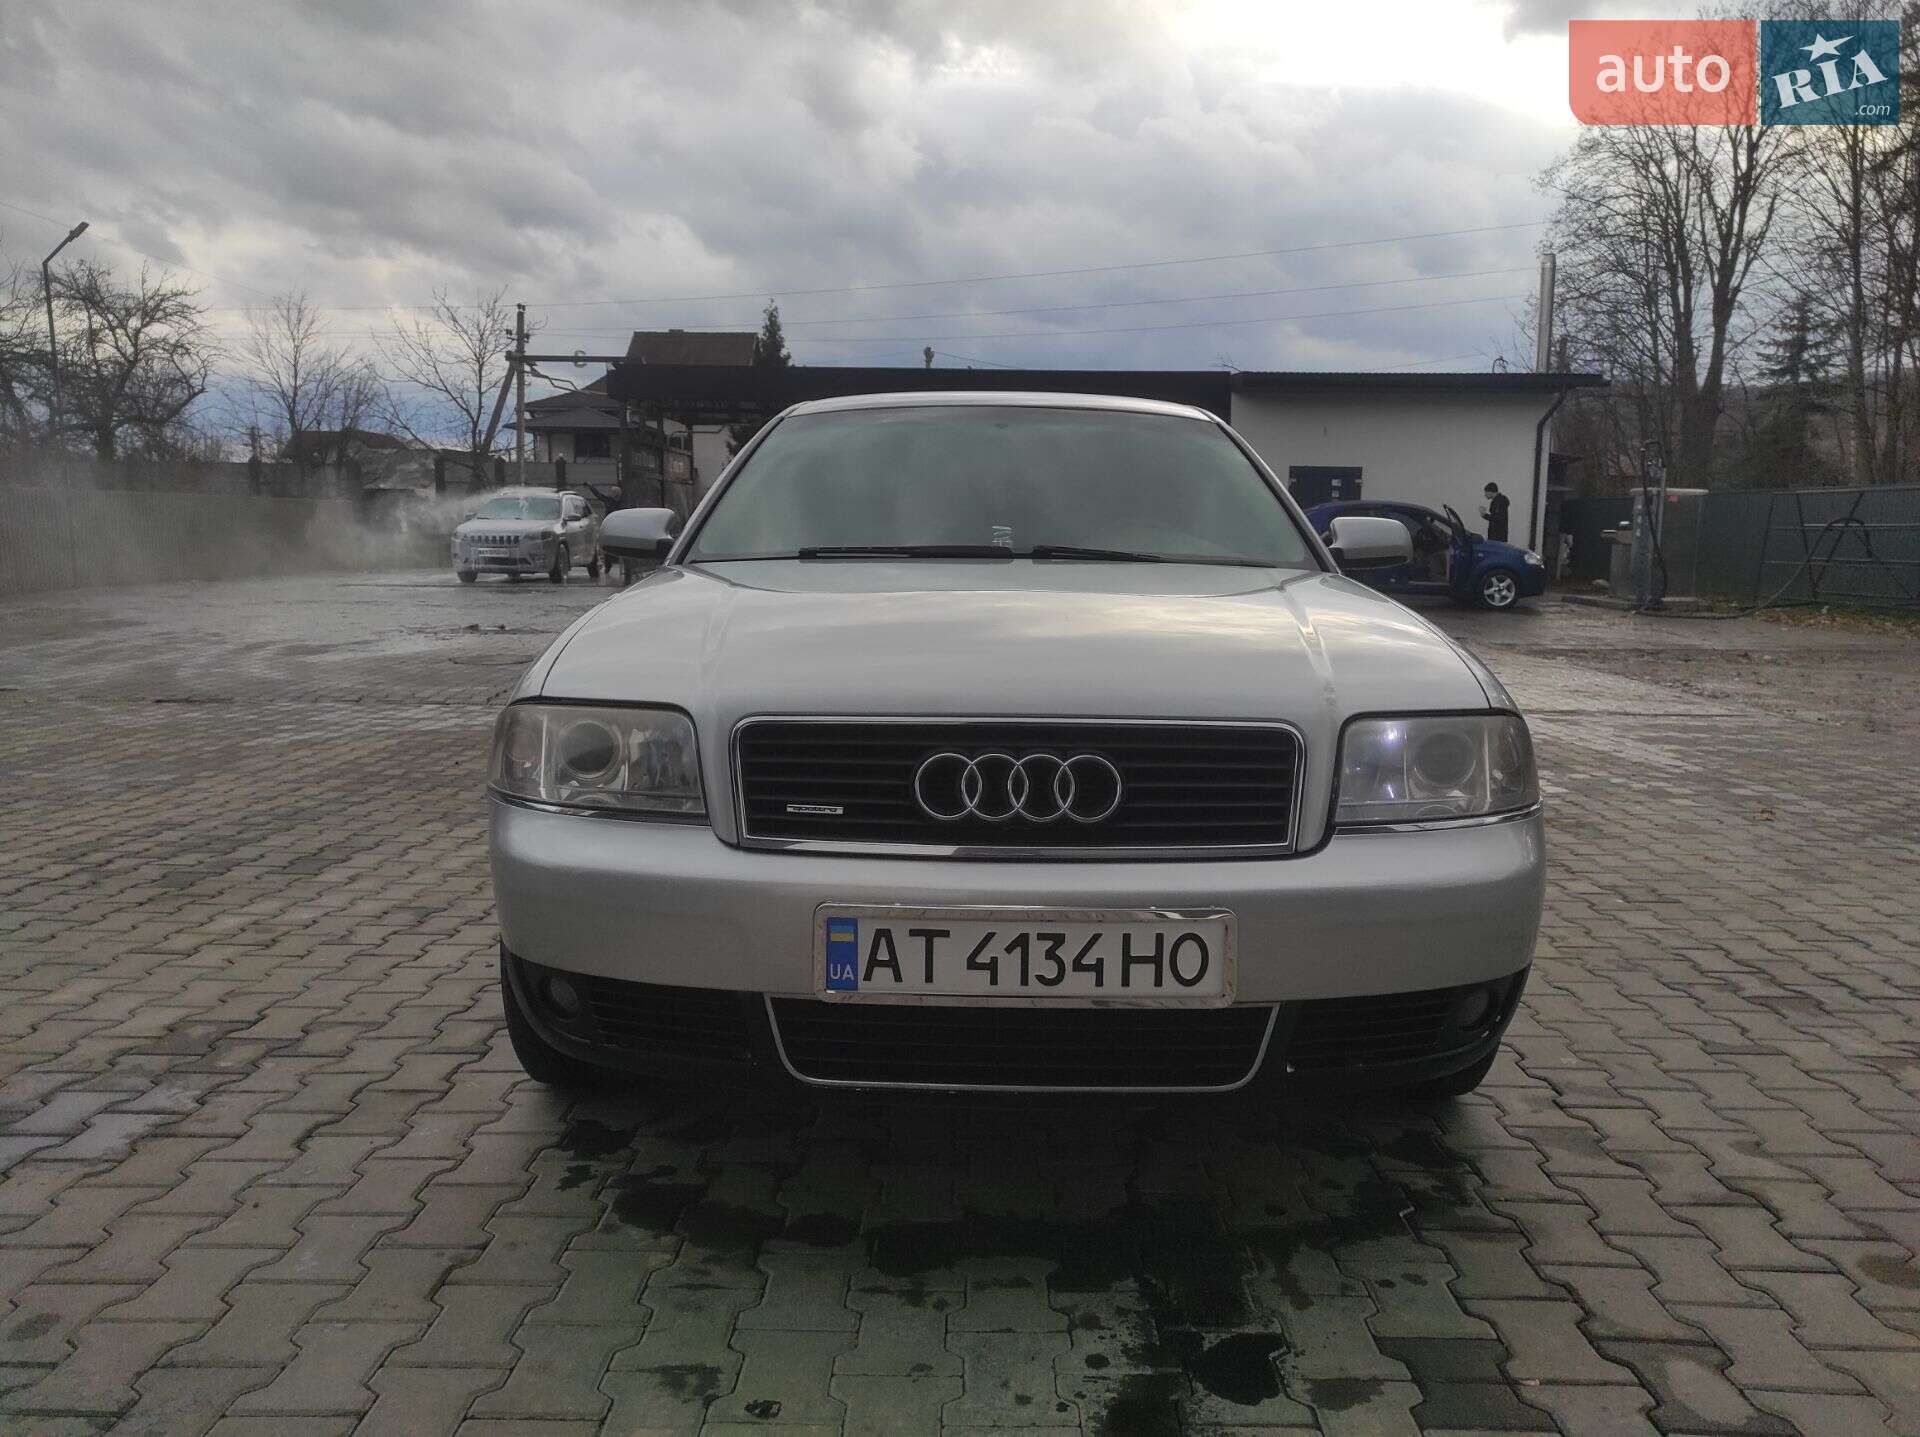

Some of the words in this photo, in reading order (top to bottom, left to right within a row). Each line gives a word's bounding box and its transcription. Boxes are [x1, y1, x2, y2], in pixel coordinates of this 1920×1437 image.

[829, 962, 855, 980] UA
[862, 928, 951, 984] AT
[966, 931, 1105, 987] 4134
[1121, 932, 1209, 988] HO
